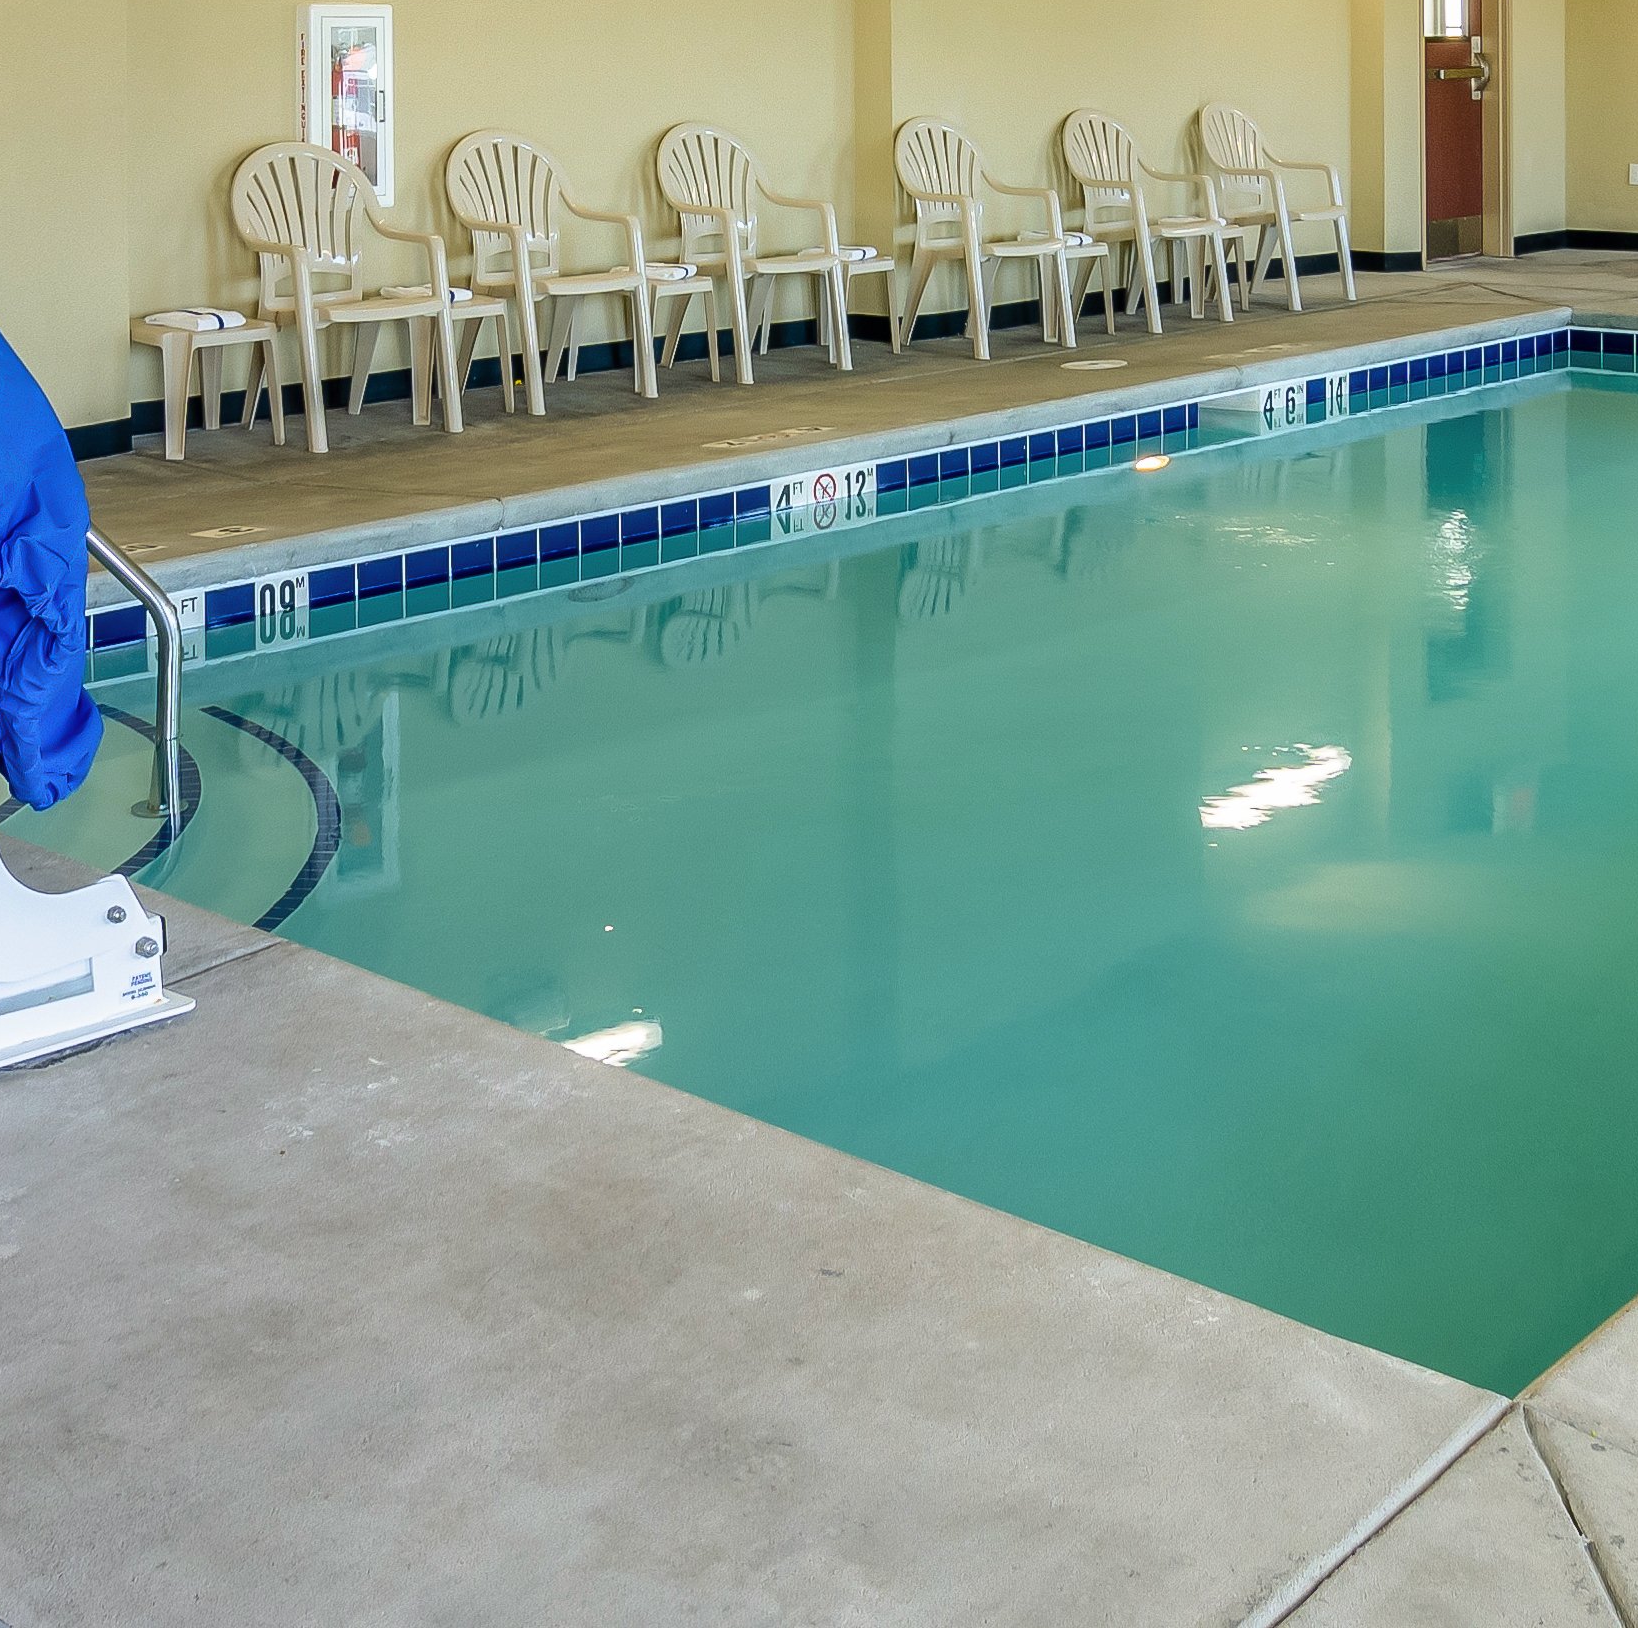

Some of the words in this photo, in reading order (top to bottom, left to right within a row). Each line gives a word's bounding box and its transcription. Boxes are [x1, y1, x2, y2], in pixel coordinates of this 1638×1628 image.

[1286, 386, 1295, 414] 6
[793, 481, 803, 495] FT
[296, 576, 305, 588] M
[181, 597, 198, 614] FT
